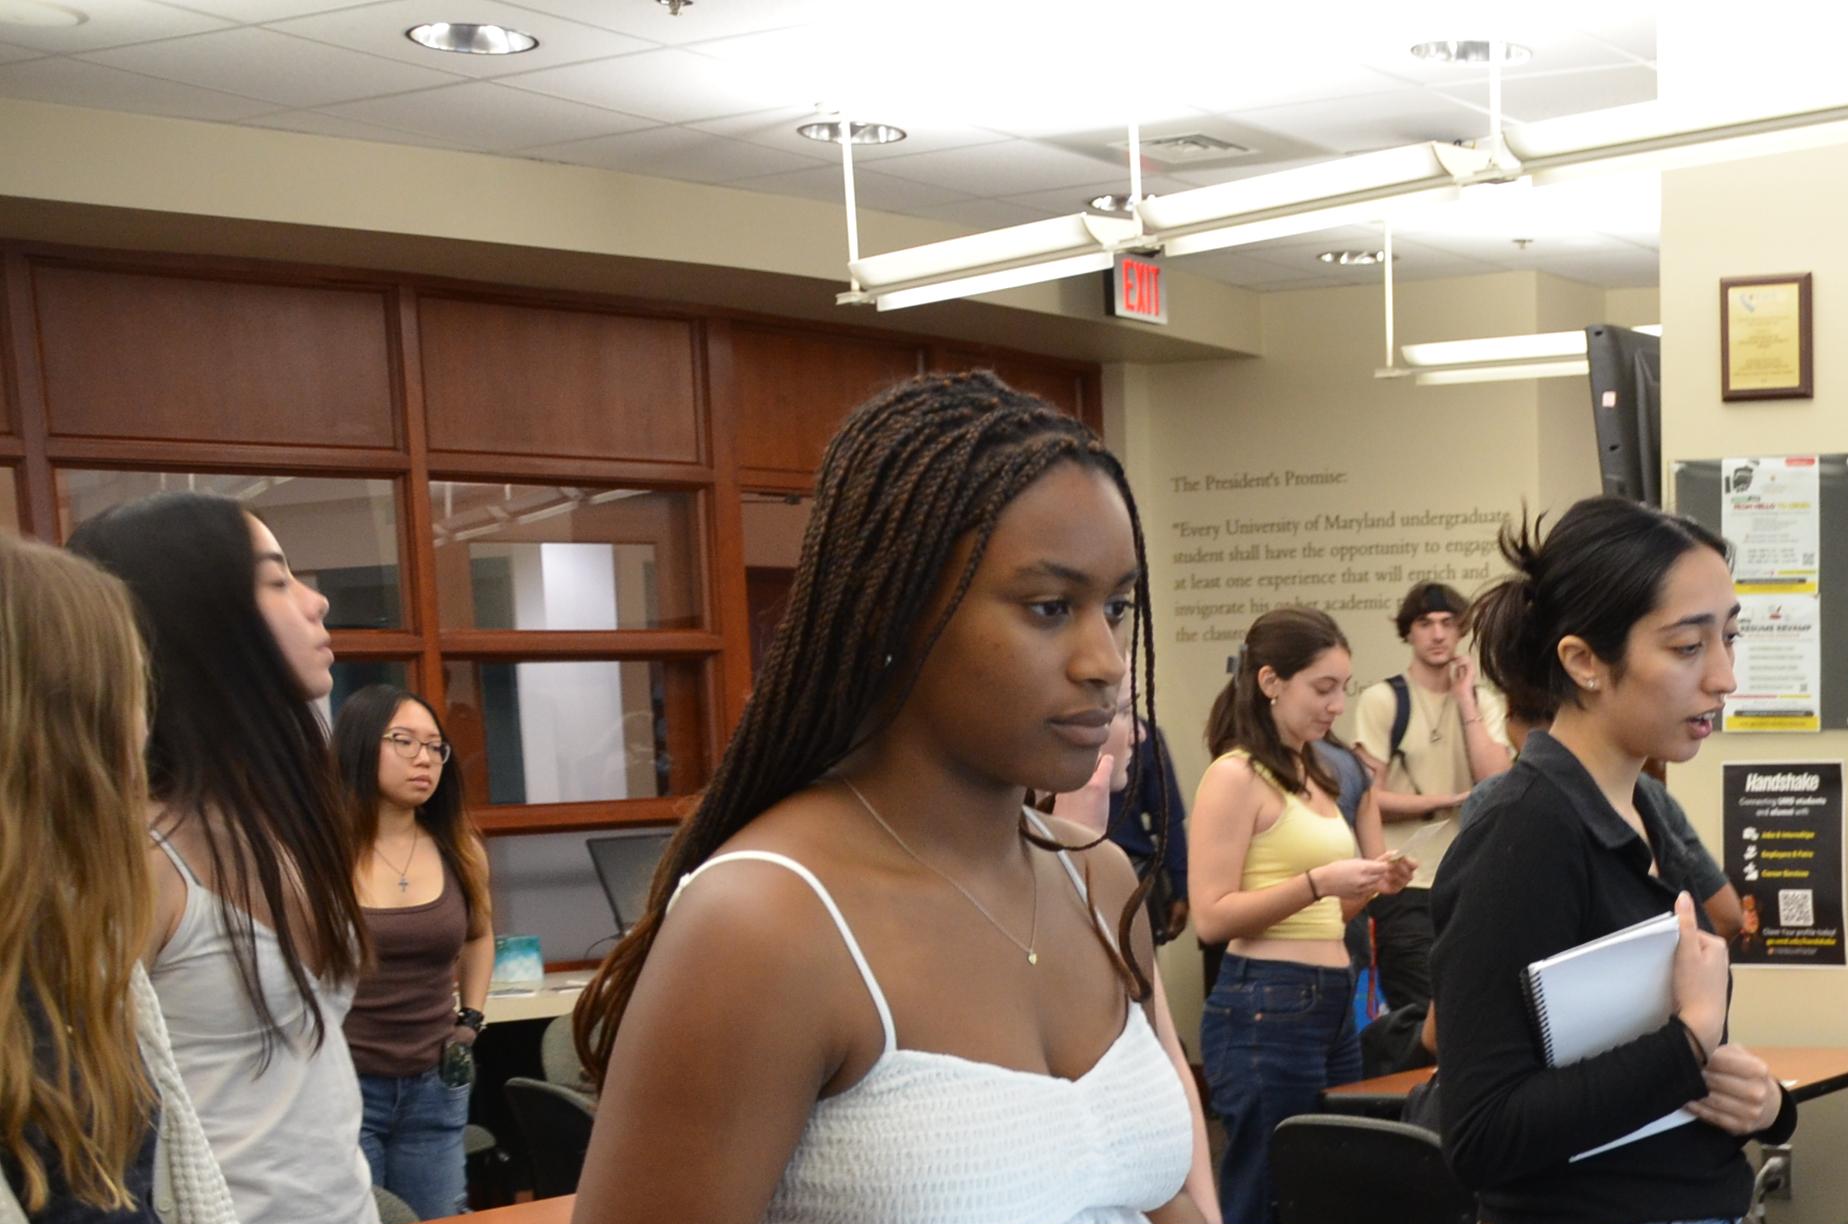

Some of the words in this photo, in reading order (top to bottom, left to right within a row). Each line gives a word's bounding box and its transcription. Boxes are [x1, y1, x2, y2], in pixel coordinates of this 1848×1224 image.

[1122, 257, 1160, 317] EXIT
[1171, 476, 1200, 493] The
[1205, 471, 1280, 491] President's
[1285, 470, 1348, 487] Promise:
[1225, 519, 1299, 536] University
[1304, 514, 1322, 531] of
[1324, 510, 1396, 533] Maryland
[1401, 506, 1510, 530] undergraduate
[1173, 547, 1224, 564] student
[1229, 545, 1260, 561] shall
[1265, 544, 1297, 560] have
[1302, 542, 1324, 558] the
[1330, 540, 1418, 562] opportunity
[1424, 540, 1440, 553] to
[1174, 578, 1187, 591] at
[1190, 573, 1221, 589] least
[1225, 576, 1252, 588] one
[1257, 571, 1337, 592] experience
[1341, 566, 1369, 584] that
[1375, 565, 1403, 582] will
[1408, 563, 1456, 582] enrich
[1461, 561, 1489, 580] and
[1174, 600, 1246, 620] invigorate
[1250, 597, 1269, 614] his
[1322, 593, 1392, 611] academic
[1175, 626, 1198, 642] the
[1745, 772, 1820, 792] Handshake
